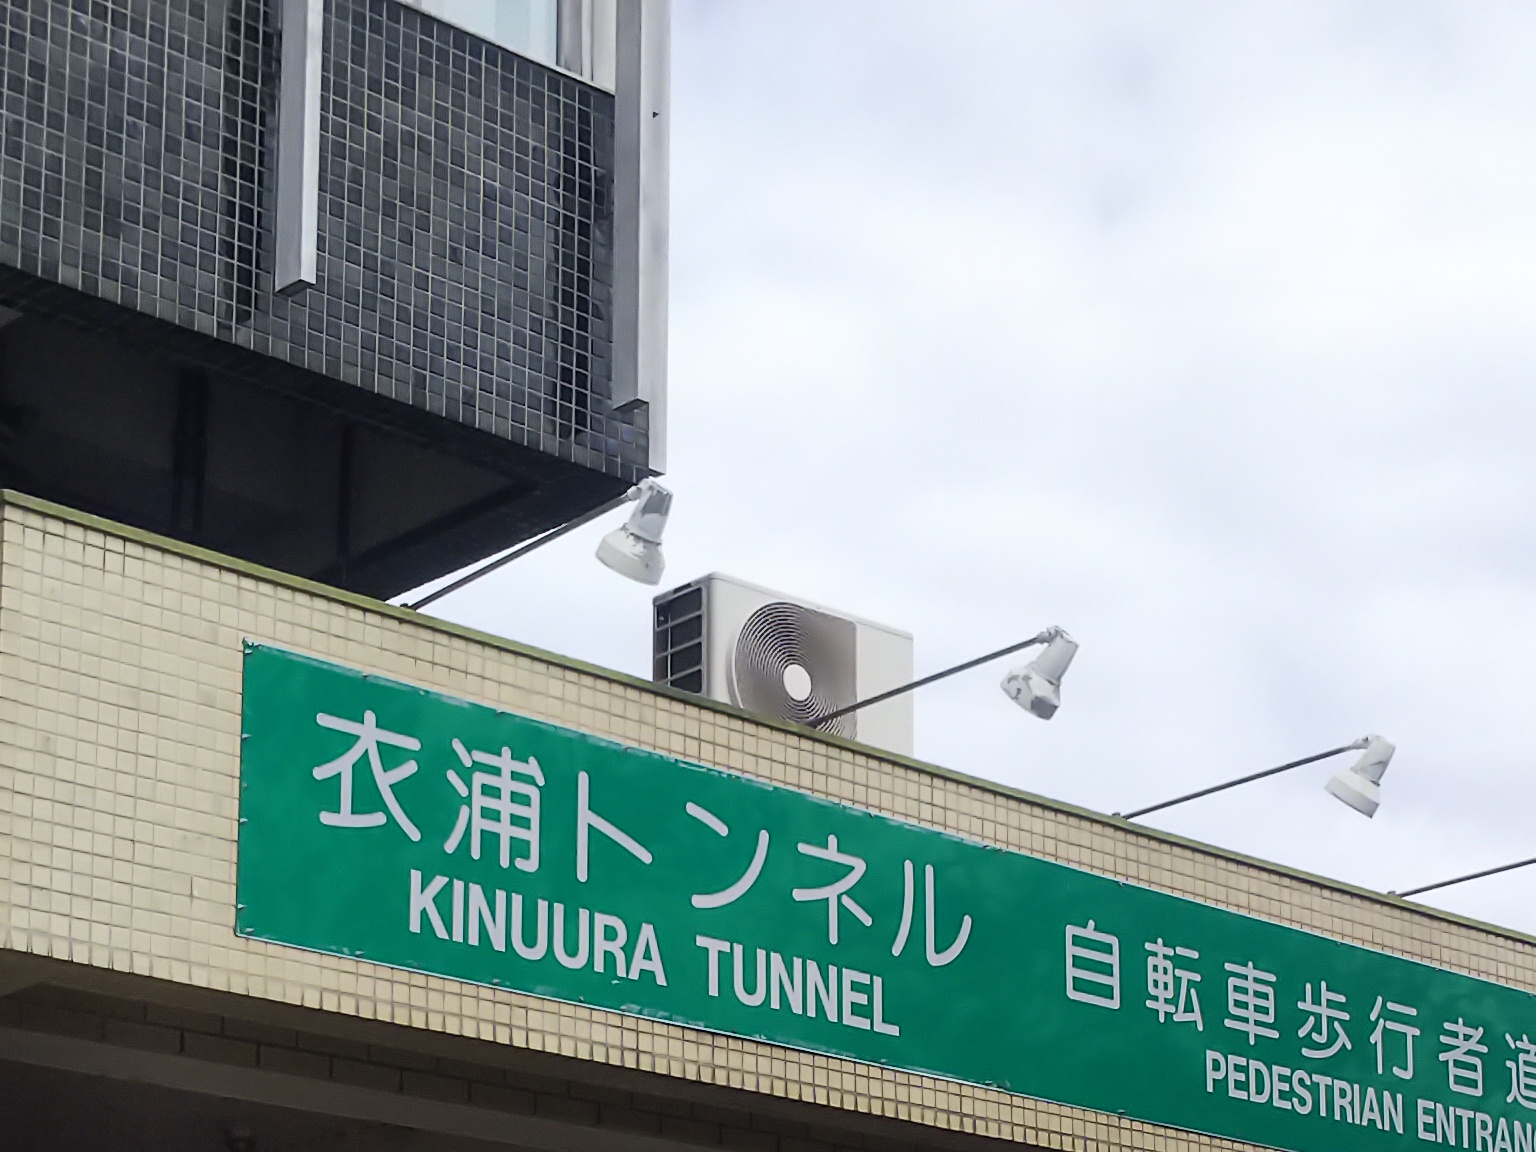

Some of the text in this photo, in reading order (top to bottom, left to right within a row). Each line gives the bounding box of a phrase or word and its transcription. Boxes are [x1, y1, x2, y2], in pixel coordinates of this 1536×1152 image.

[313, 709, 972, 966] 衣浦トンネル
[409, 869, 900, 1037] KINUURA TUNNEL
[1206, 1049, 1403, 1134] PEDESTRIAN
